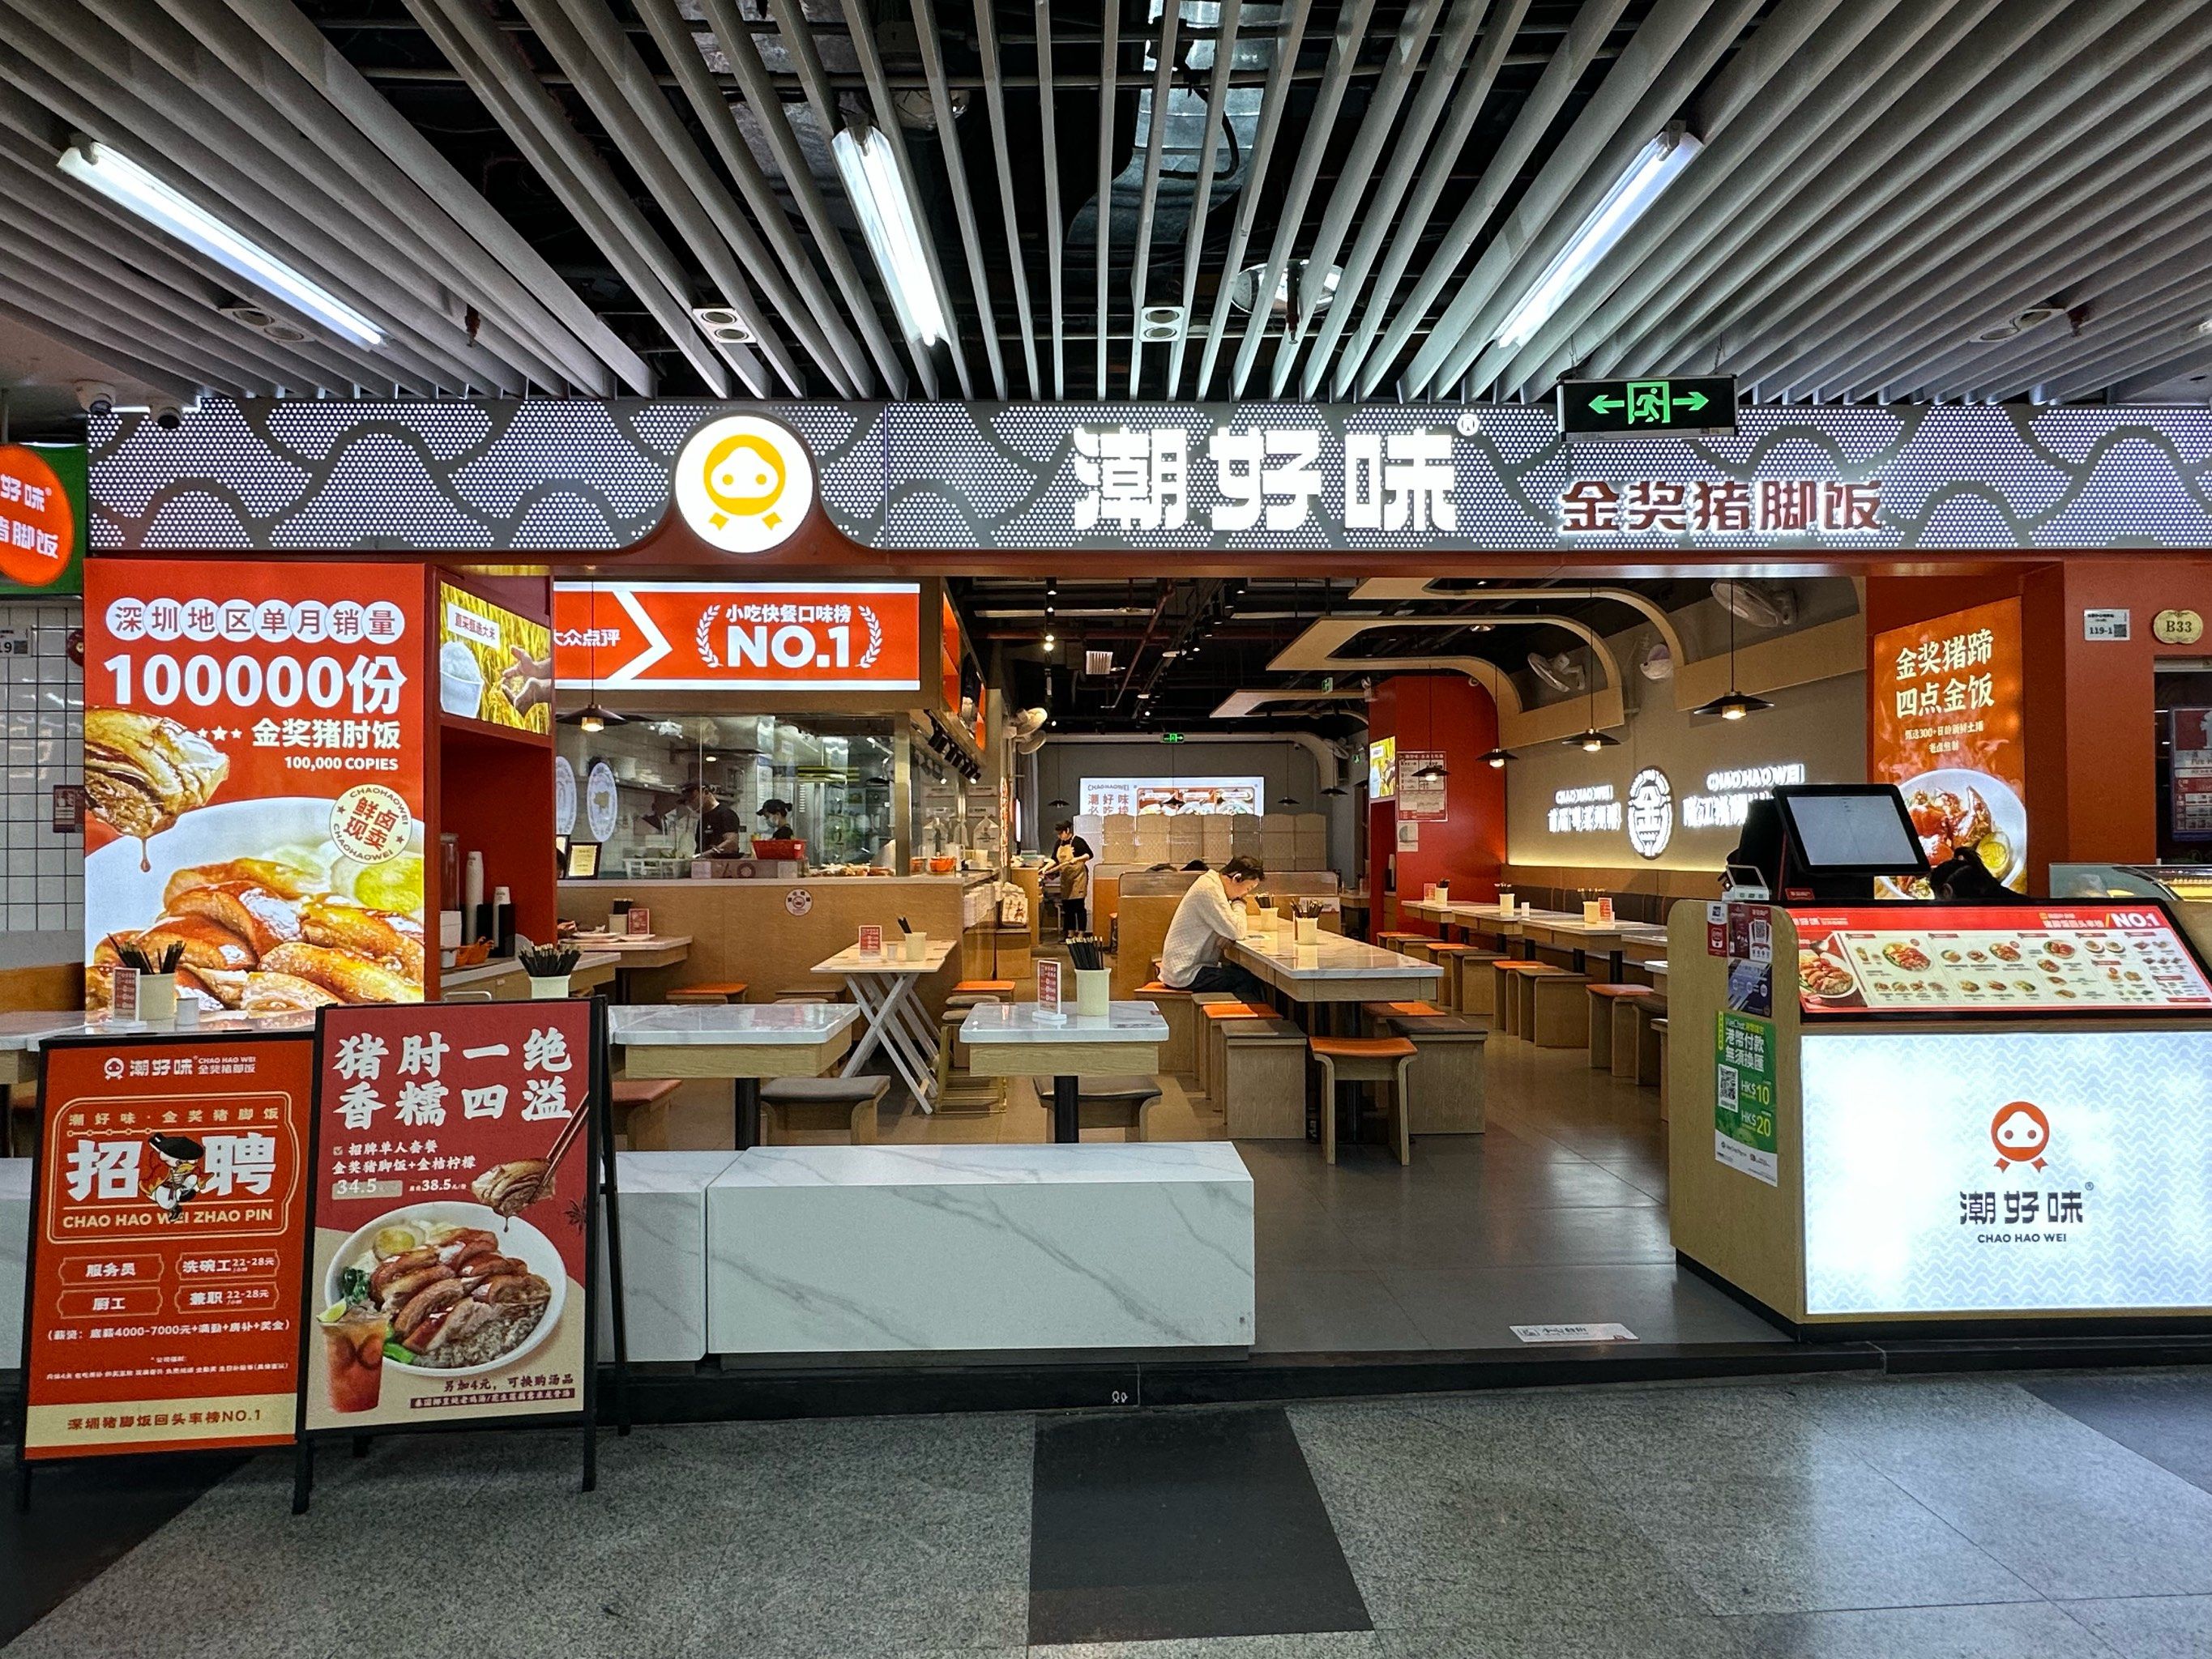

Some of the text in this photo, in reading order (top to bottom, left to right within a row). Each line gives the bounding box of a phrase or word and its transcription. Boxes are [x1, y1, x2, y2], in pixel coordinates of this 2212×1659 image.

[1074, 426, 1457, 532] 潮好味
[1, 474, 45, 513] 好味
[1561, 480, 1883, 533] 金奖猪脚饭
[114, 605, 395, 637] 深圳地区单月销量
[726, 603, 852, 623] 小吃快餐口味榜
[2090, 626, 2113, 634] 119-1
[2166, 621, 2193, 633] B33
[728, 625, 850, 668] NO.1
[1895, 628, 1994, 681] 金奖猪蹄
[104, 655, 408, 714] 100000份
[1896, 672, 1995, 719] 四点金饭
[251, 718, 401, 749] 金奖猪肘饭
[284, 756, 399, 771] 100,000 COPIES
[349, 787, 408, 825] CHAOHAOWEI
[1087, 793, 1129, 806] 潮好味
[352, 796, 399, 833] 鲜卤
[333, 823, 394, 861] CHAOHAOWEI
[343, 816, 388, 851] 现卖
[2111, 913, 2161, 928] NO.1
[333, 1027, 573, 1080] 猪肘一绝
[130, 1058, 194, 1077] 潮好味
[333, 1076, 573, 1130] 香糯四溢
[348, 1139, 438, 1157] 招牌单人套餐
[332, 1155, 476, 1175] 金奖猪脚饭+金桔柠檬
[336, 1178, 378, 1195] 34.5
[62, 1214, 111, 1228] CHAO
[115, 1213, 152, 1226] HAO
[194, 1209, 241, 1224] ZHAO
[245, 1208, 273, 1222] PIN
[1959, 1191, 2084, 1226] 潮好味
[1977, 1233, 2067, 1243] CHAO HAO WEI
[85, 1261, 136, 1278] 服务员
[182, 1259, 232, 1274] 洗碗工
[92, 1296, 126, 1311] 厨工
[189, 1290, 223, 1306] 兼职
[67, 1410, 262, 1431] 深圳猪脚饭回头率榜NO.1
